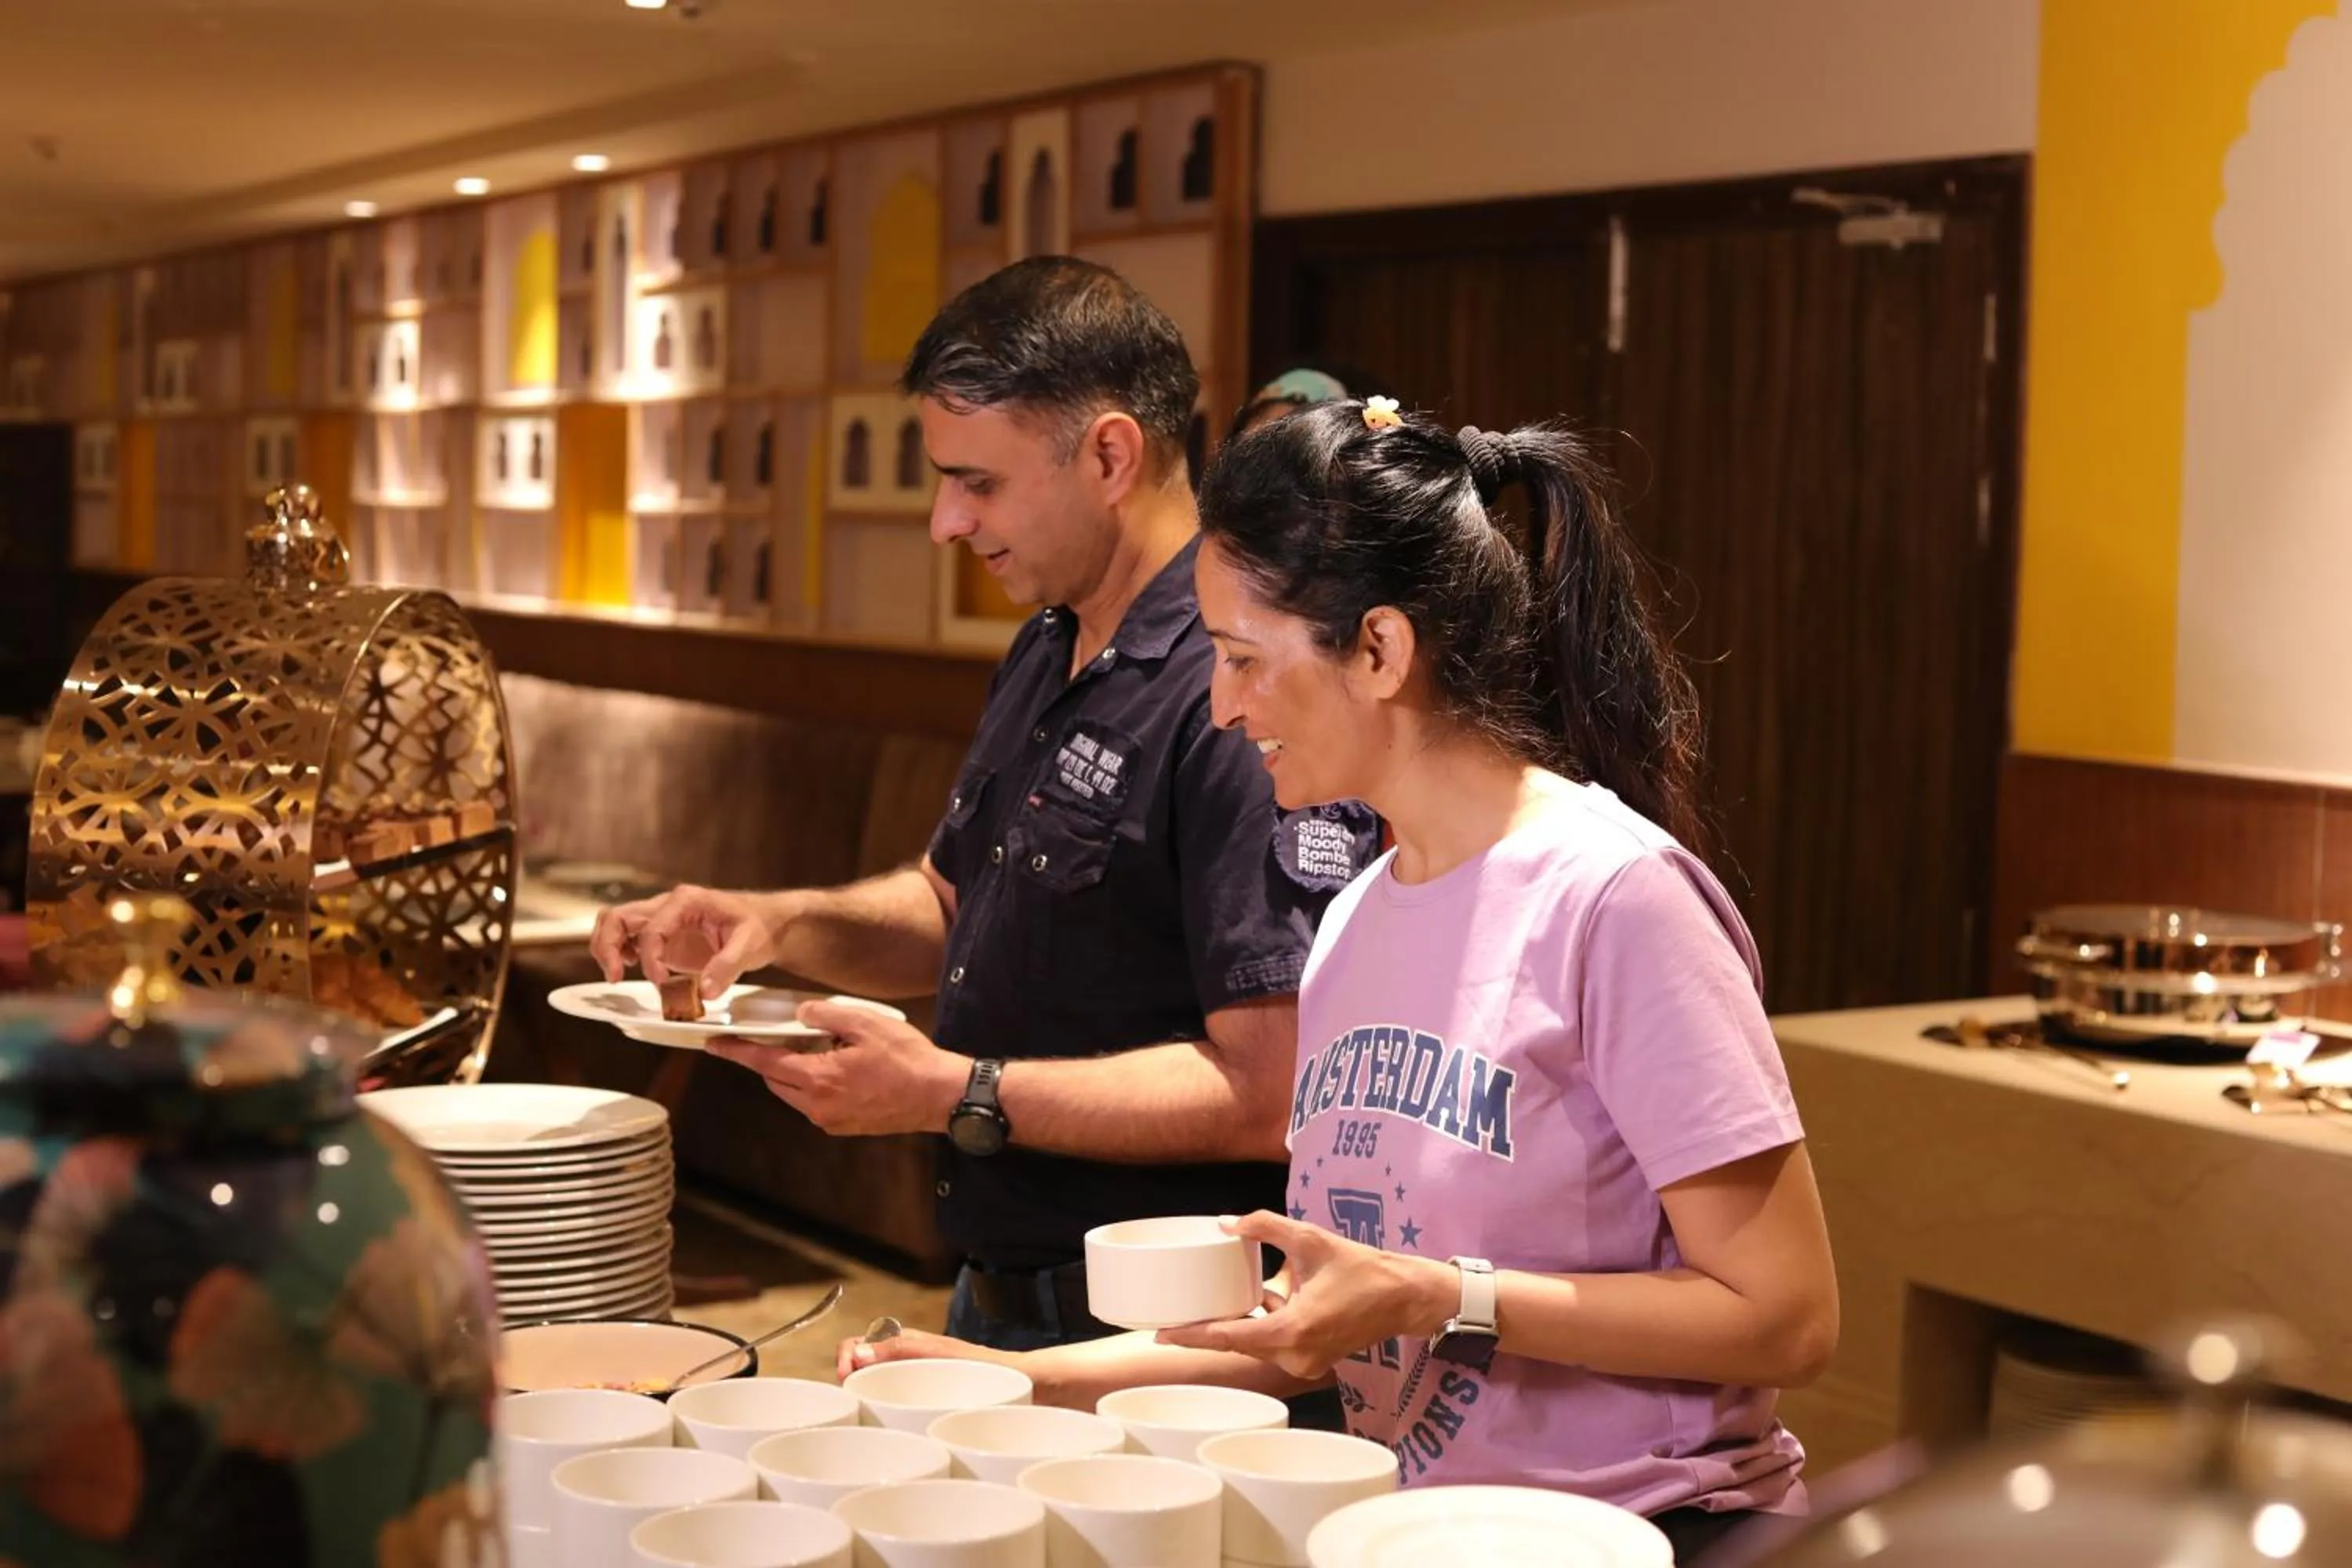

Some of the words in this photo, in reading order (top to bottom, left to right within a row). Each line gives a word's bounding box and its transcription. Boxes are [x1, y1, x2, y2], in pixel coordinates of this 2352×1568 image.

[1298, 835, 1347, 854] Moody
[1292, 1023, 1515, 1163] AMSTERDAM
[1331, 1120, 1382, 1159] 1995
